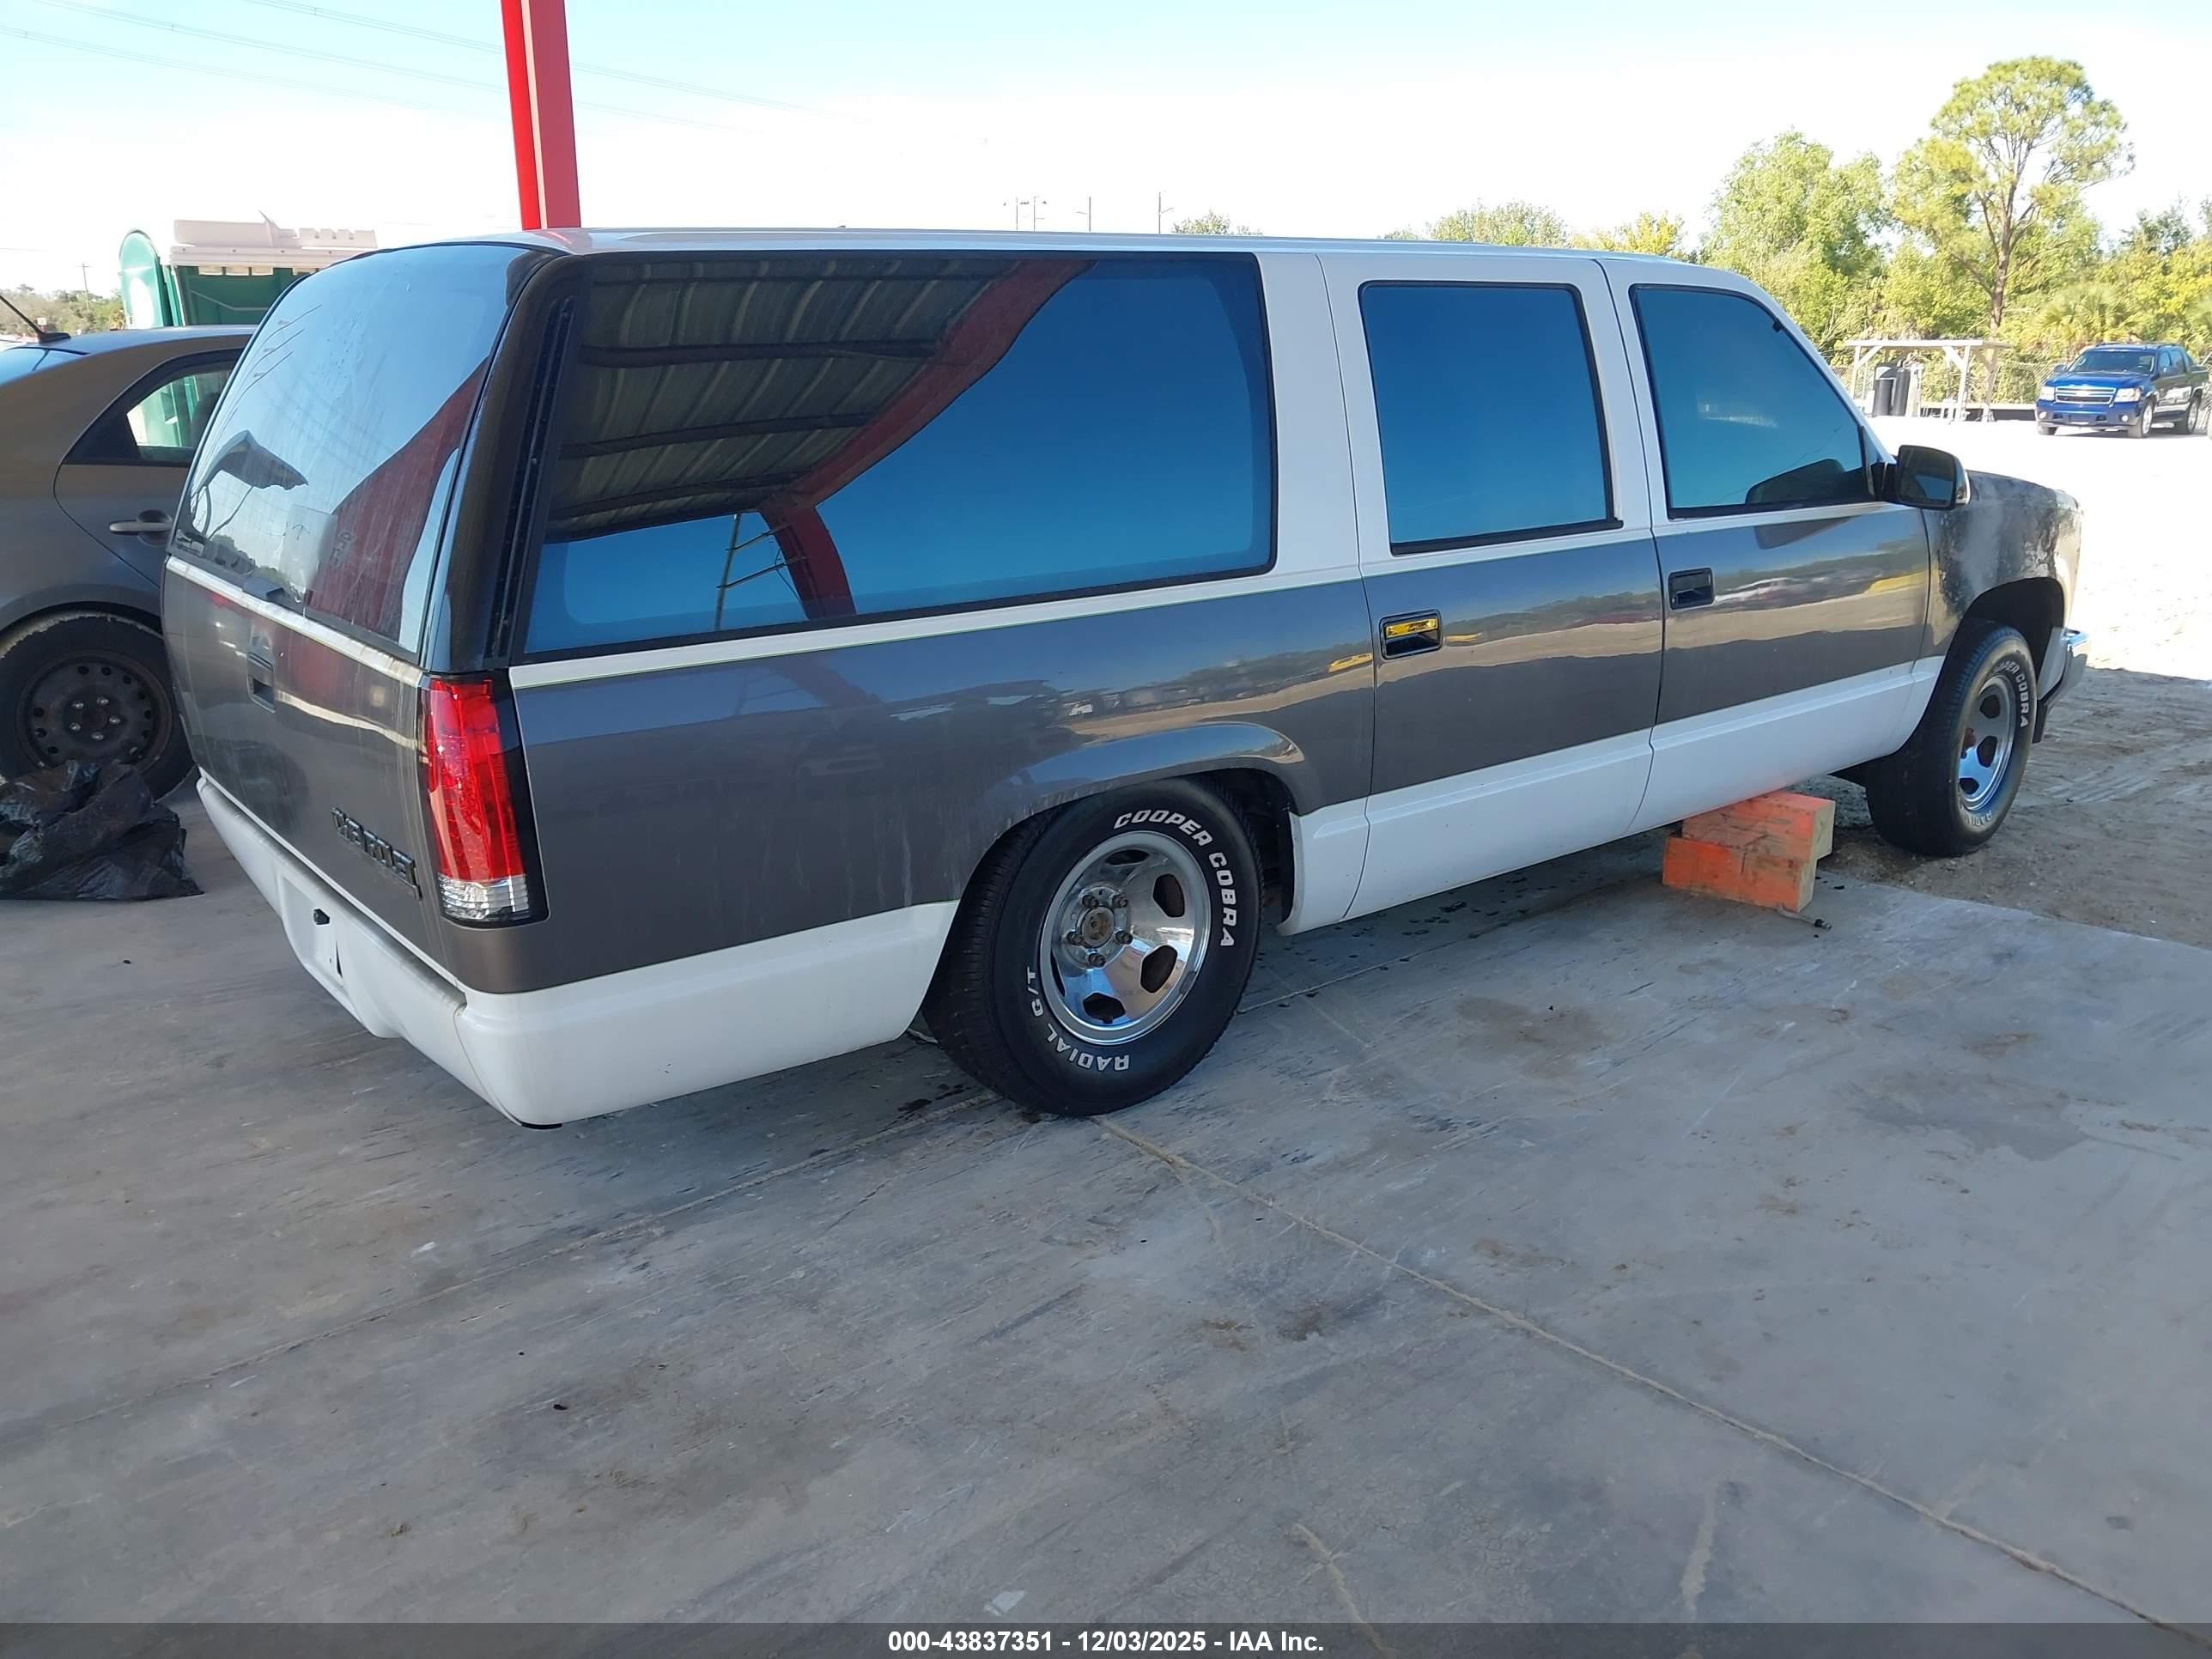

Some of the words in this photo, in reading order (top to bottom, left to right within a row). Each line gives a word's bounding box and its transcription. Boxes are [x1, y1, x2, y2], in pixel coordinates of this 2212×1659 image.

[2015, 673, 2030, 728] COBRA
[1114, 809, 1213, 847] COOPER
[1208, 851, 1237, 947] COBRA
[1026, 965, 1043, 1017] G/T
[1047, 1023, 1130, 1071] RADIAL
